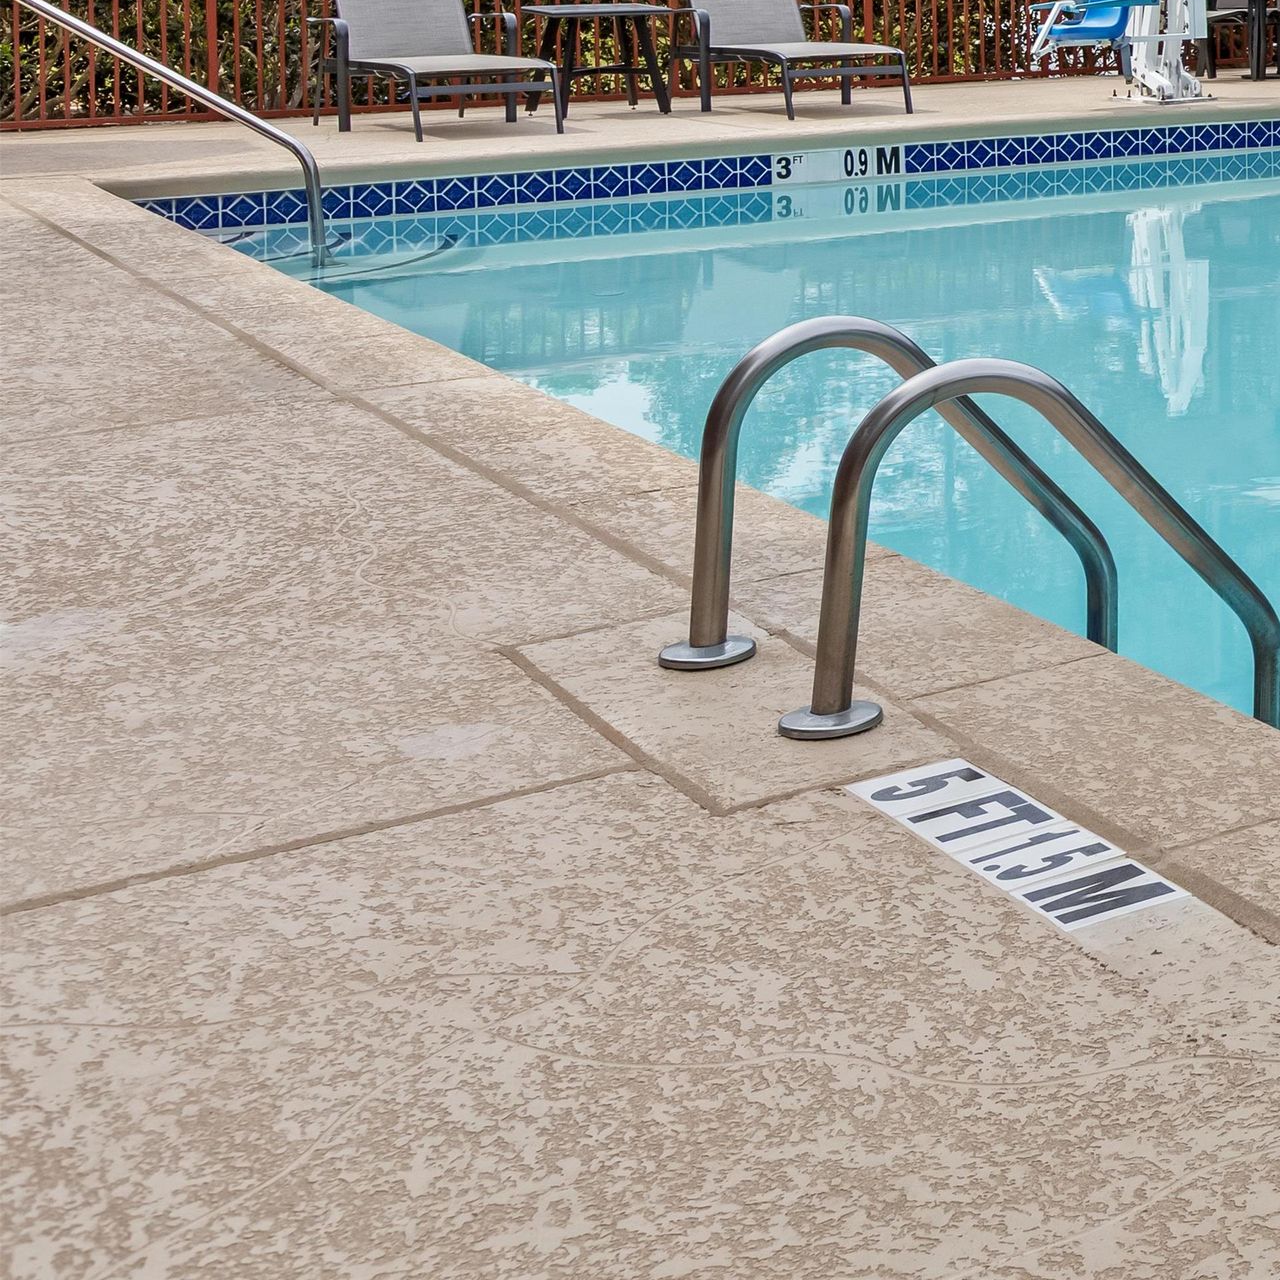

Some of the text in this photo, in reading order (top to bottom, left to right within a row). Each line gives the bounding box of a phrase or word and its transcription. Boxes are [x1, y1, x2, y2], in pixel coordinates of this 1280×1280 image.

[844, 148, 868, 177] 0.9
[876, 146, 901, 175] M
[870, 767, 986, 802] 5
[1022, 863, 1177, 925] M
